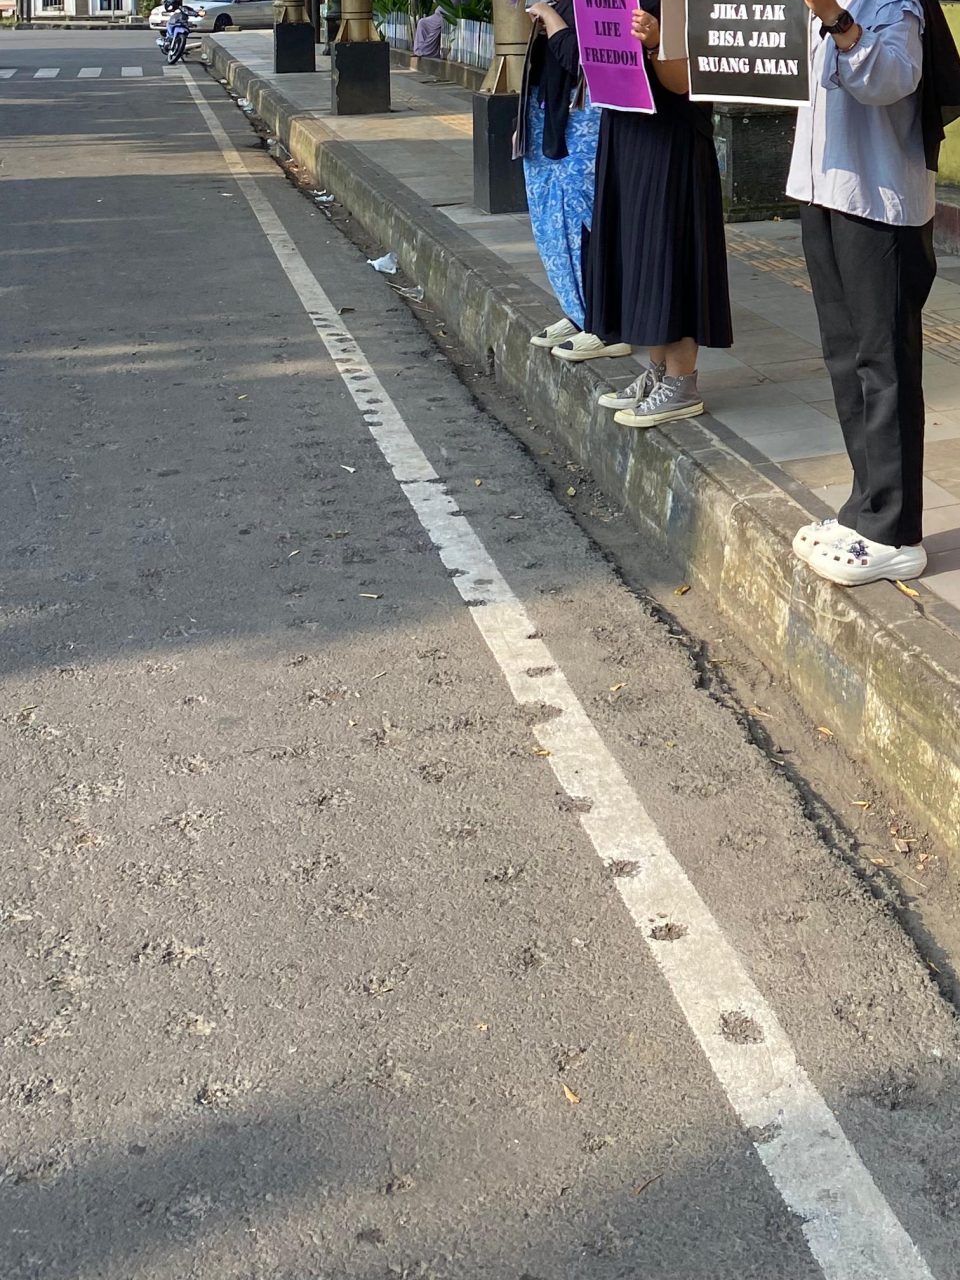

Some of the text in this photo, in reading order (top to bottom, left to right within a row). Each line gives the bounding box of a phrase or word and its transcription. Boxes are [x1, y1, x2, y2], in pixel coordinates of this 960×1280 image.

[710, 4, 785, 20] JIKA TAK
[595, 21, 621, 37] LIFE
[708, 31, 786, 48] BISA JADI
[584, 48, 638, 67] FREEDOM
[698, 57, 798, 75] RUANG AMAN
